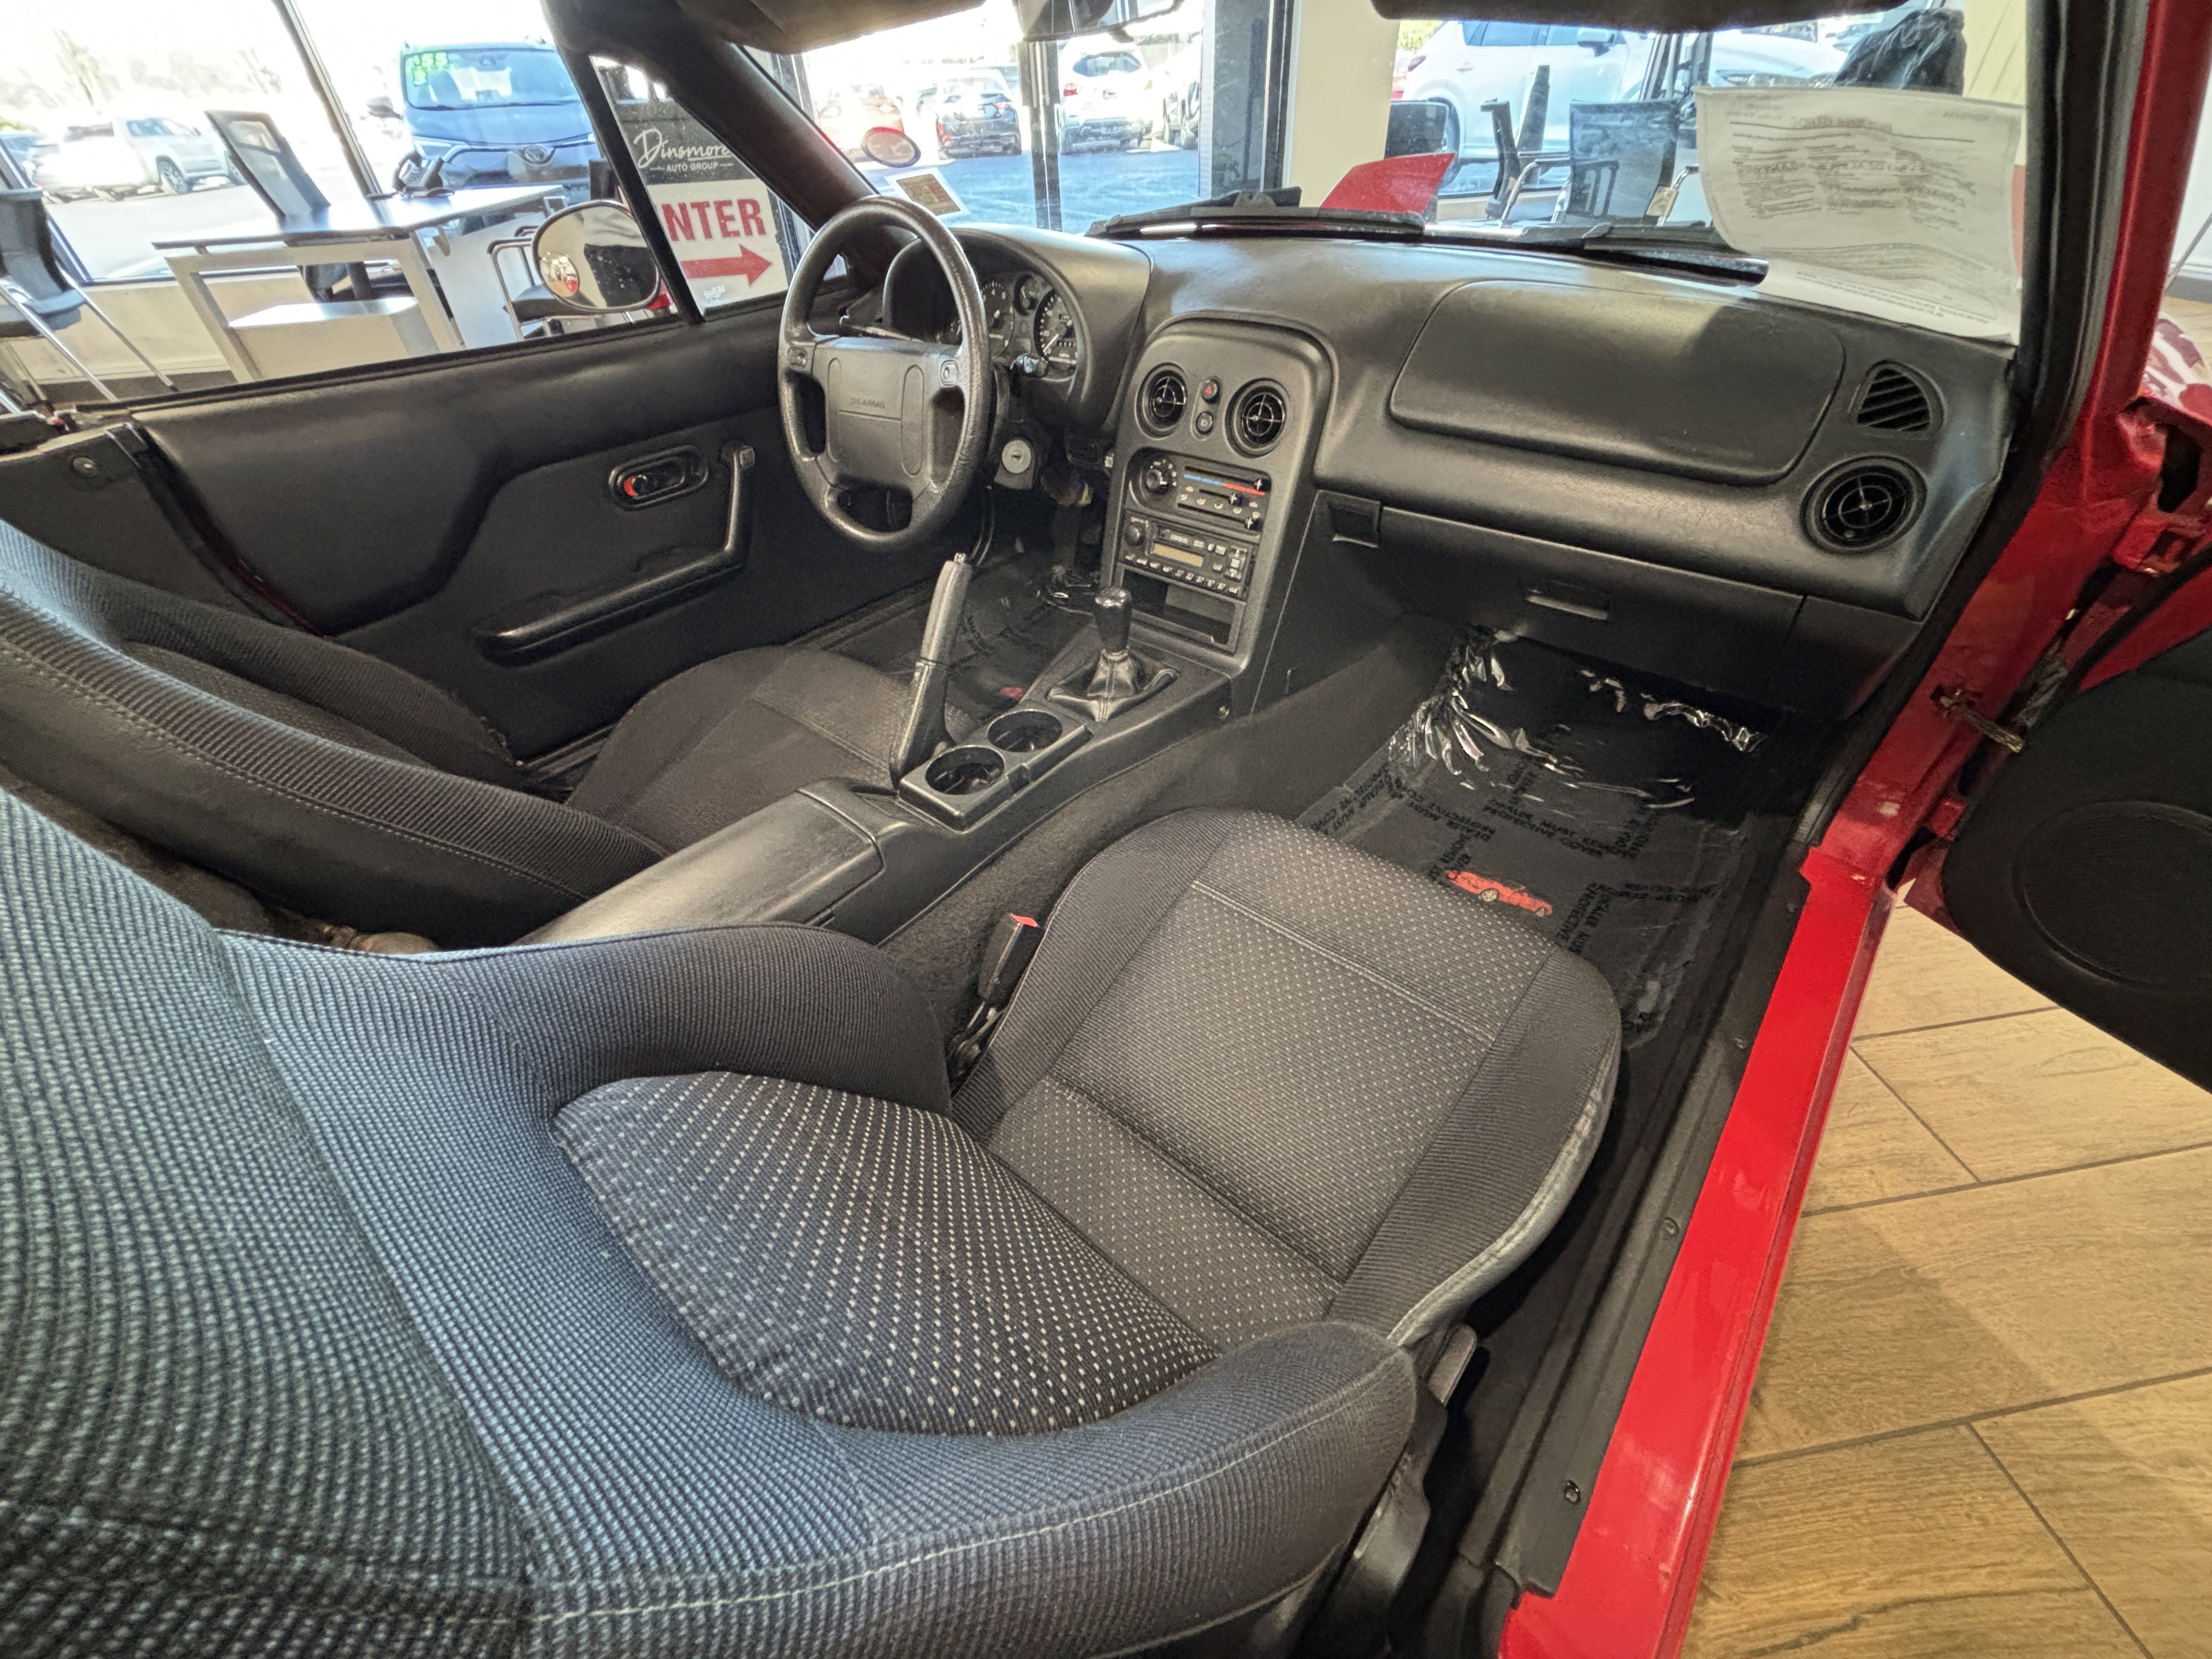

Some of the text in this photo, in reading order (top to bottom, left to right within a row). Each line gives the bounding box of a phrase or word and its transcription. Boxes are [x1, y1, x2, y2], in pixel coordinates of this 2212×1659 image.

[634, 128, 730, 169] Dinsmore
[666, 161, 718, 171] AUTO GROUP
[662, 198, 766, 241] NTER
